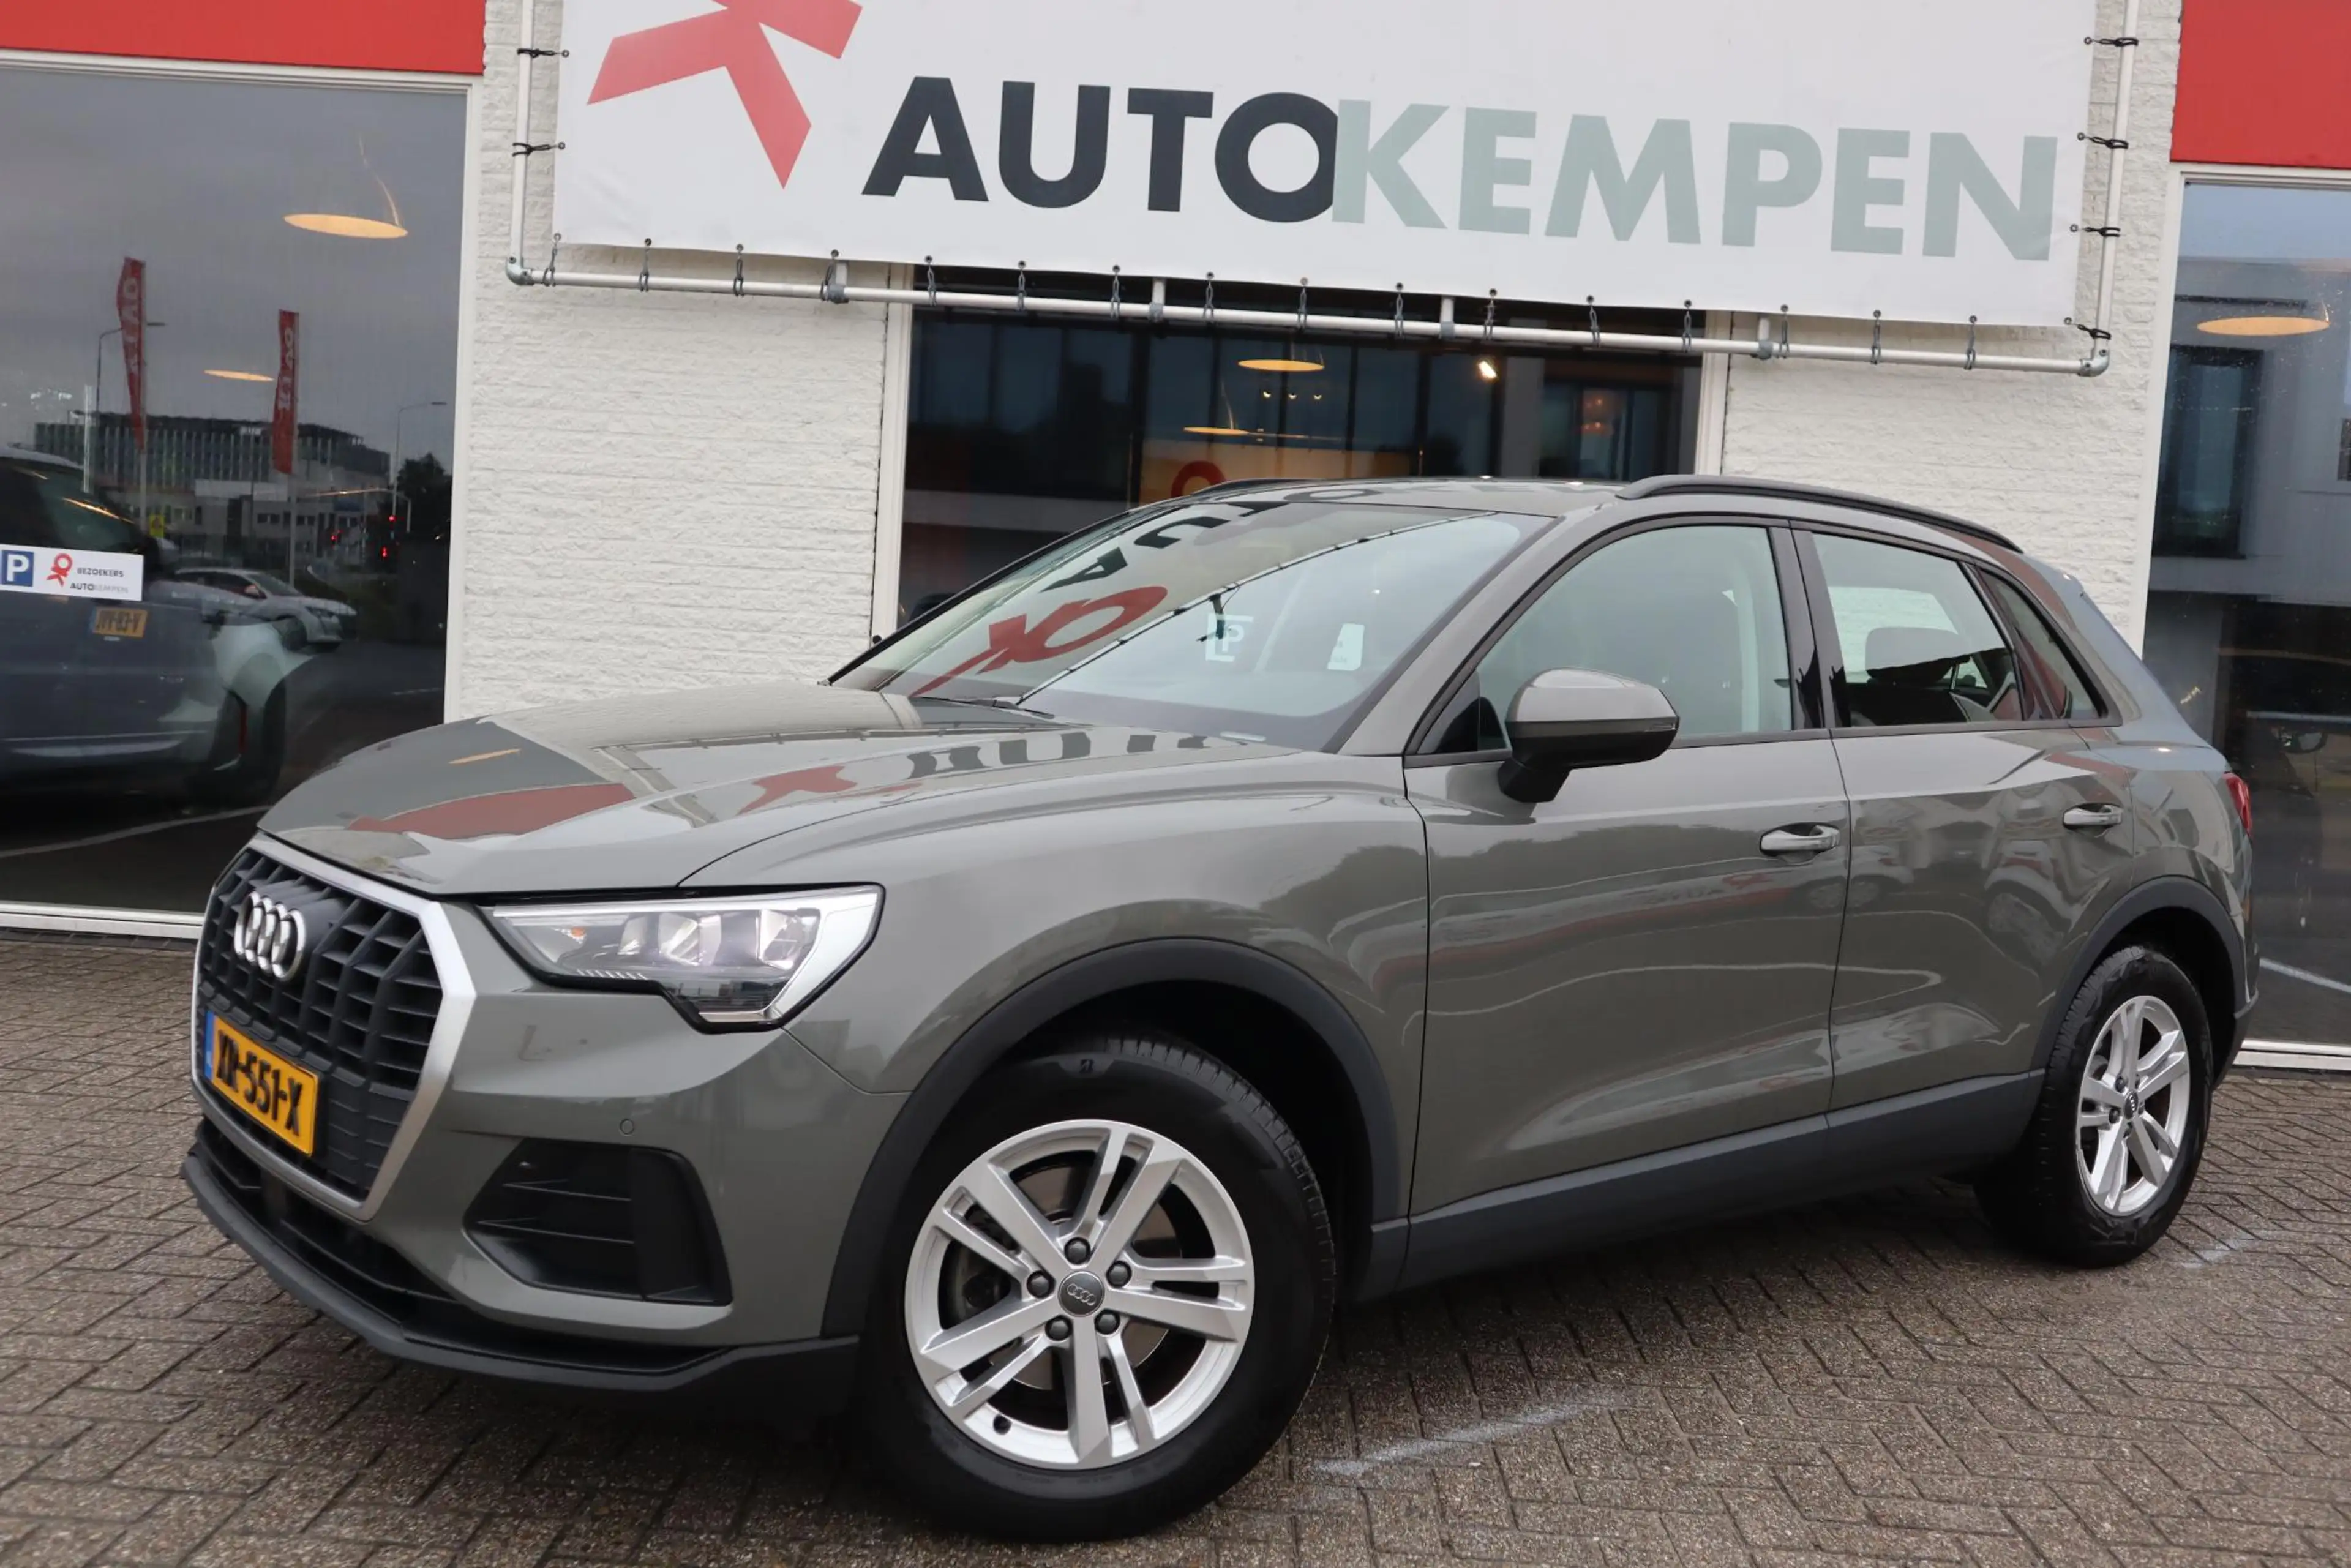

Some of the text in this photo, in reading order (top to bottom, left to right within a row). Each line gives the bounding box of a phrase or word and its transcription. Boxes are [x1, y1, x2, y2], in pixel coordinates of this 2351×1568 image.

[861, 76, 2058, 261] AUTOKEMPEN
[7, 553, 29, 582] P
[77, 567, 124, 577] BEZOEKERS
